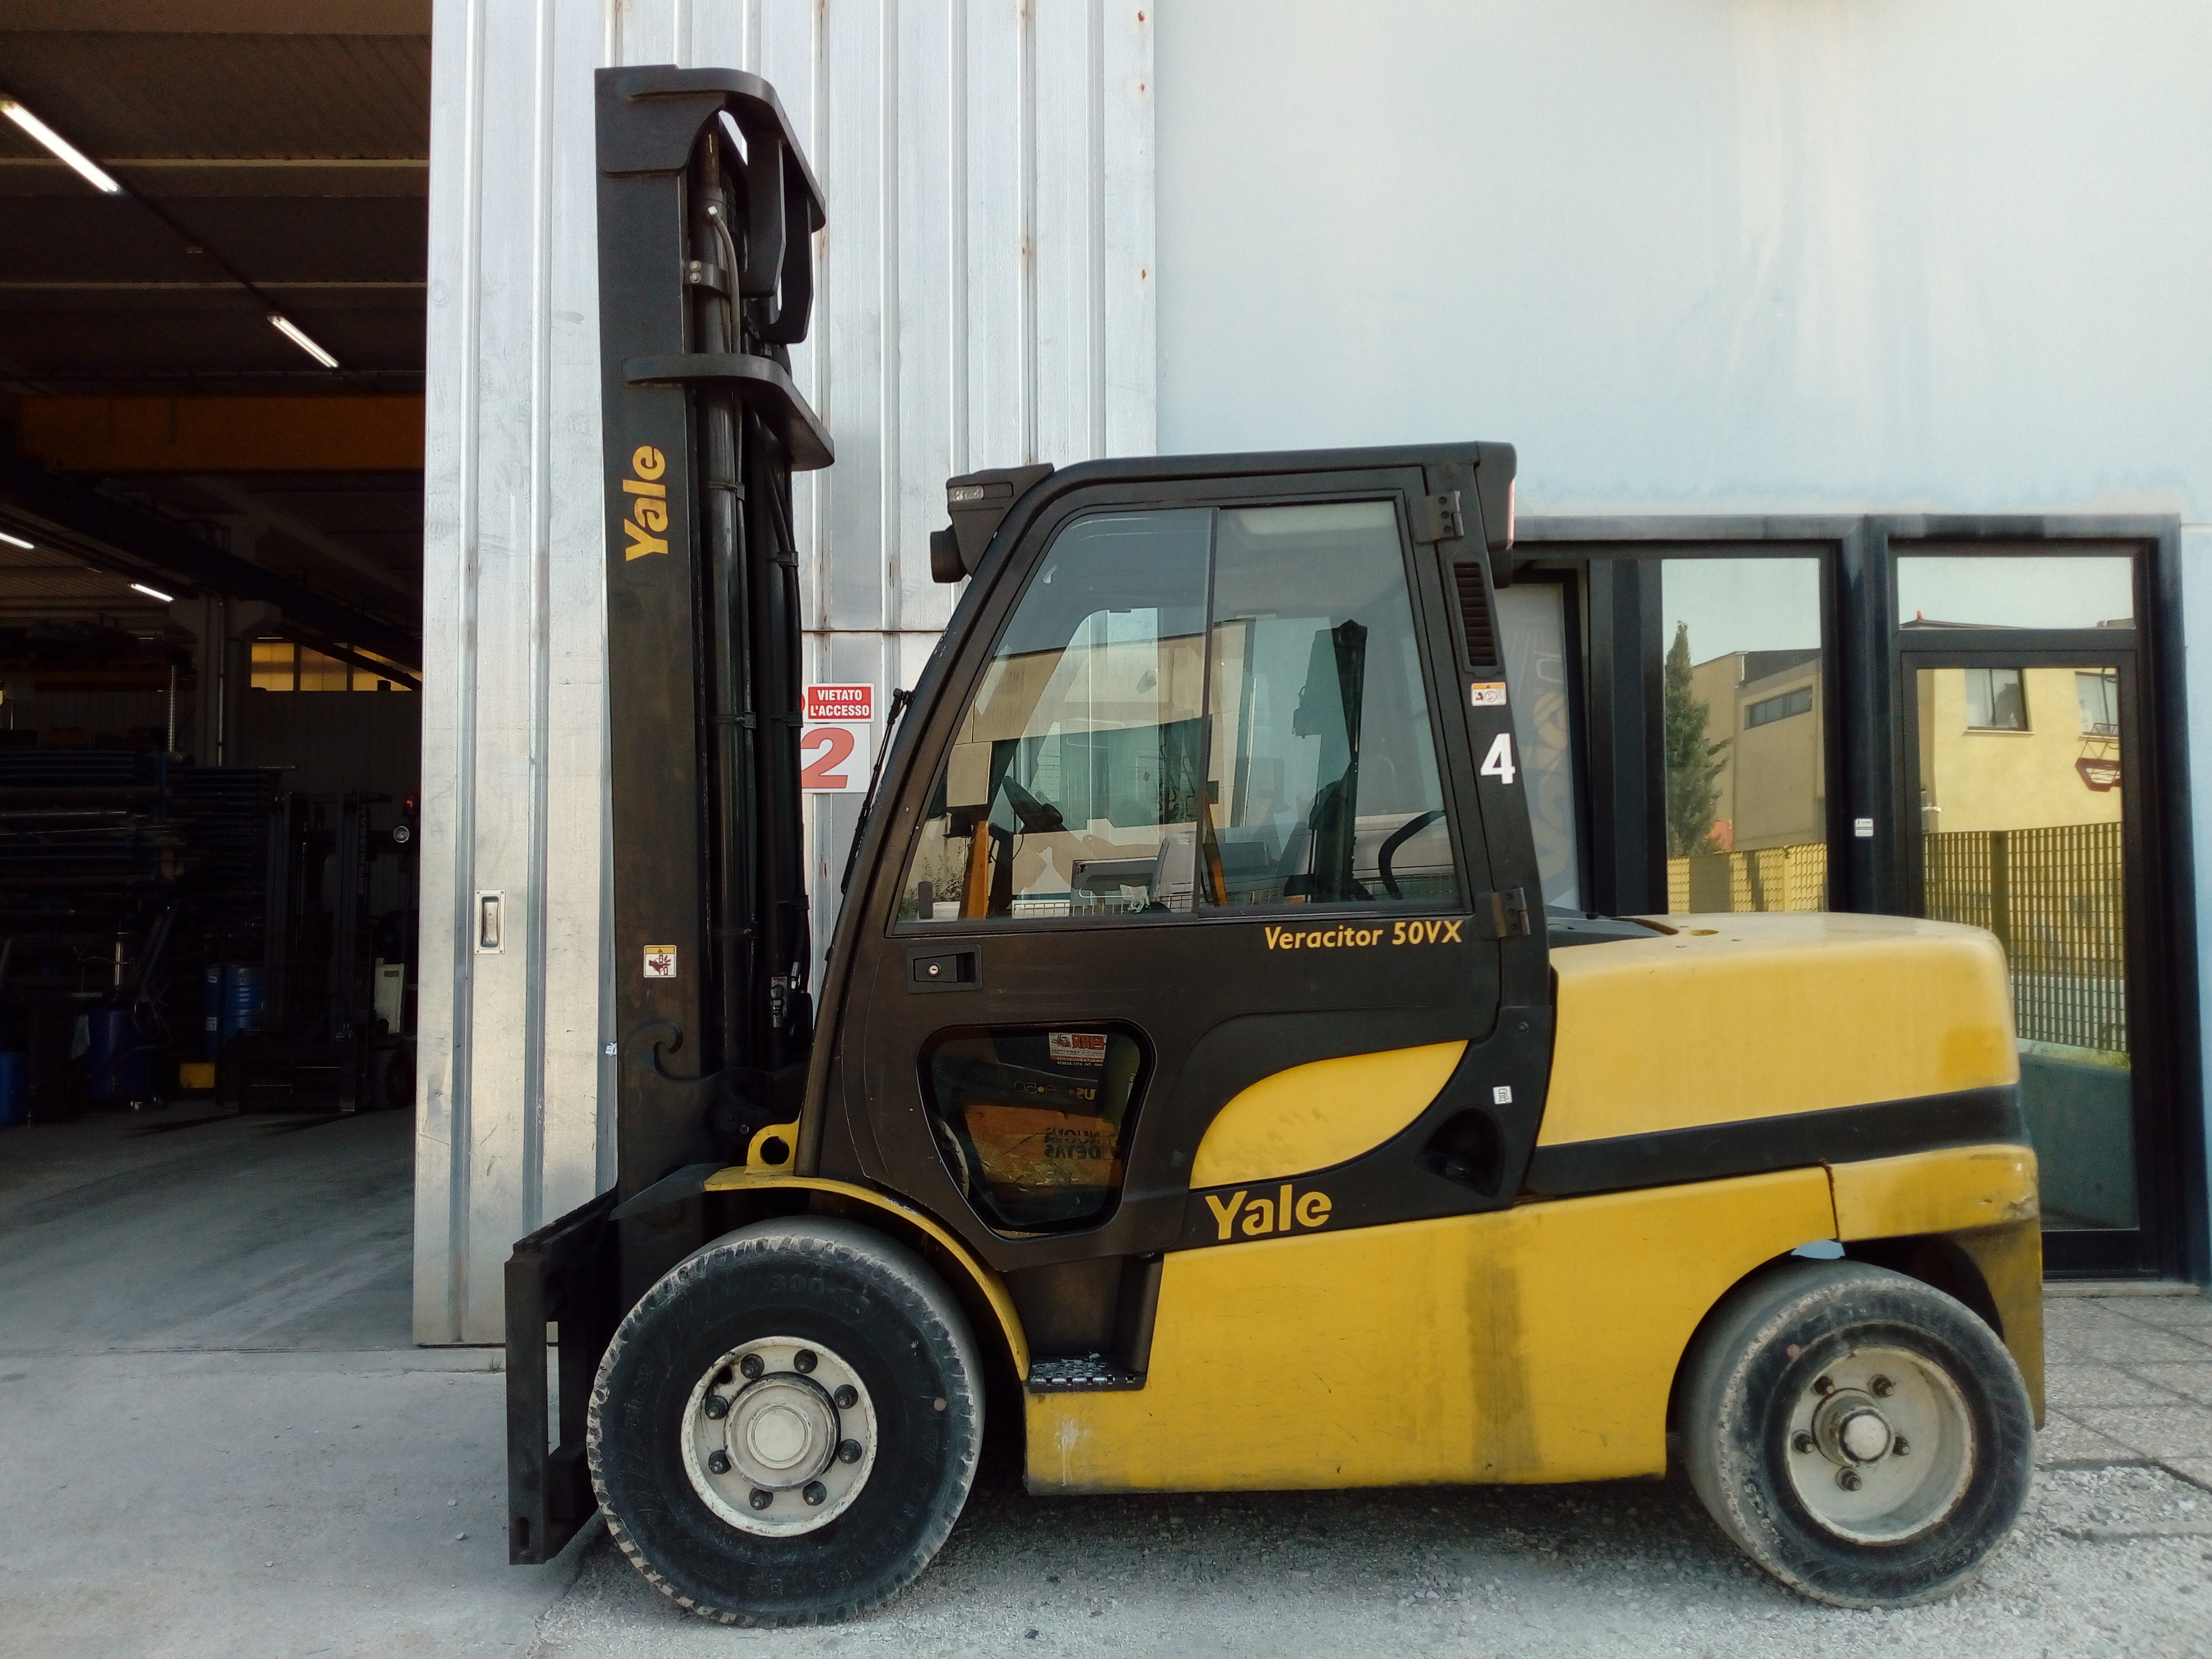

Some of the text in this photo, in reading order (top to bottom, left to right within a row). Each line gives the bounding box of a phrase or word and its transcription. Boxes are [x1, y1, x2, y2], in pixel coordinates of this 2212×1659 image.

[623, 446, 668, 562] Yale
[810, 705, 869, 716] L'ACCESSO
[817, 690, 862, 701] VIETATO
[801, 727, 854, 789] 2
[1480, 733, 1515, 784] 4
[1264, 919, 1463, 950] Veracitor 50VX
[1205, 1184, 1332, 1240] Yale
